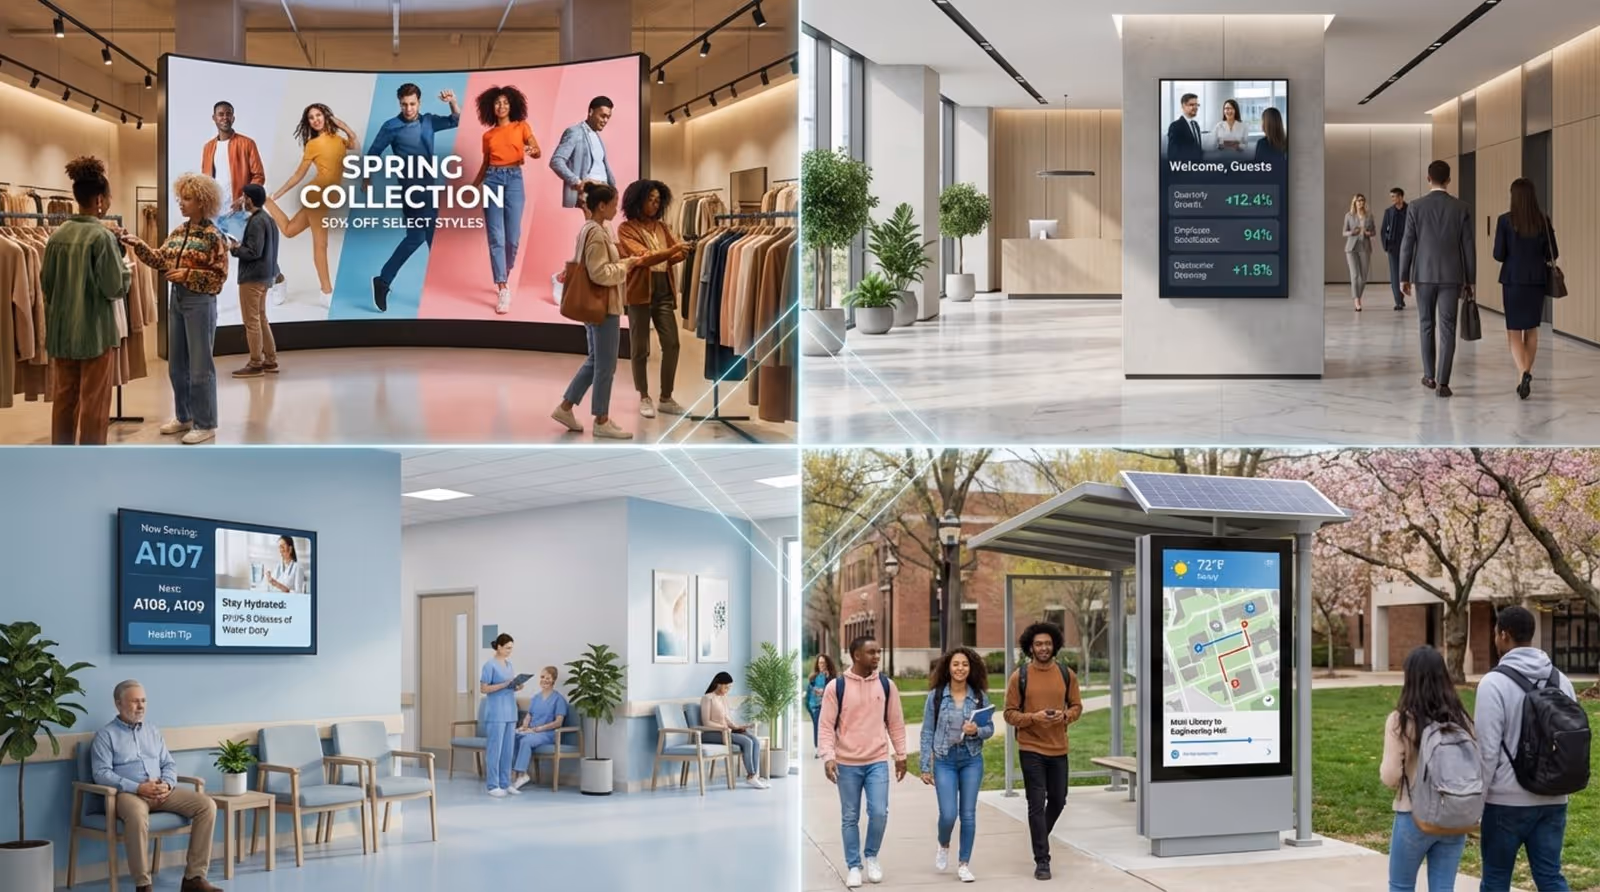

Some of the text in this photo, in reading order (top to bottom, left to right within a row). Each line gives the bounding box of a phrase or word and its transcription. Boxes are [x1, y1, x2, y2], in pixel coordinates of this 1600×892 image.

[342, 155, 462, 179] SPRING
[1169, 160, 1272, 174] Welcome, Guests
[300, 184, 504, 209] COLLECTION
[352, 217, 379, 229] OFF
[382, 217, 430, 229] SELECT
[435, 217, 484, 229] STYLES
[1244, 229, 1273, 241] 94%
[141, 523, 161, 534] Now
[134, 540, 203, 569] A107
[133, 597, 205, 613] A108, A109
[222, 625, 247, 635] Water
